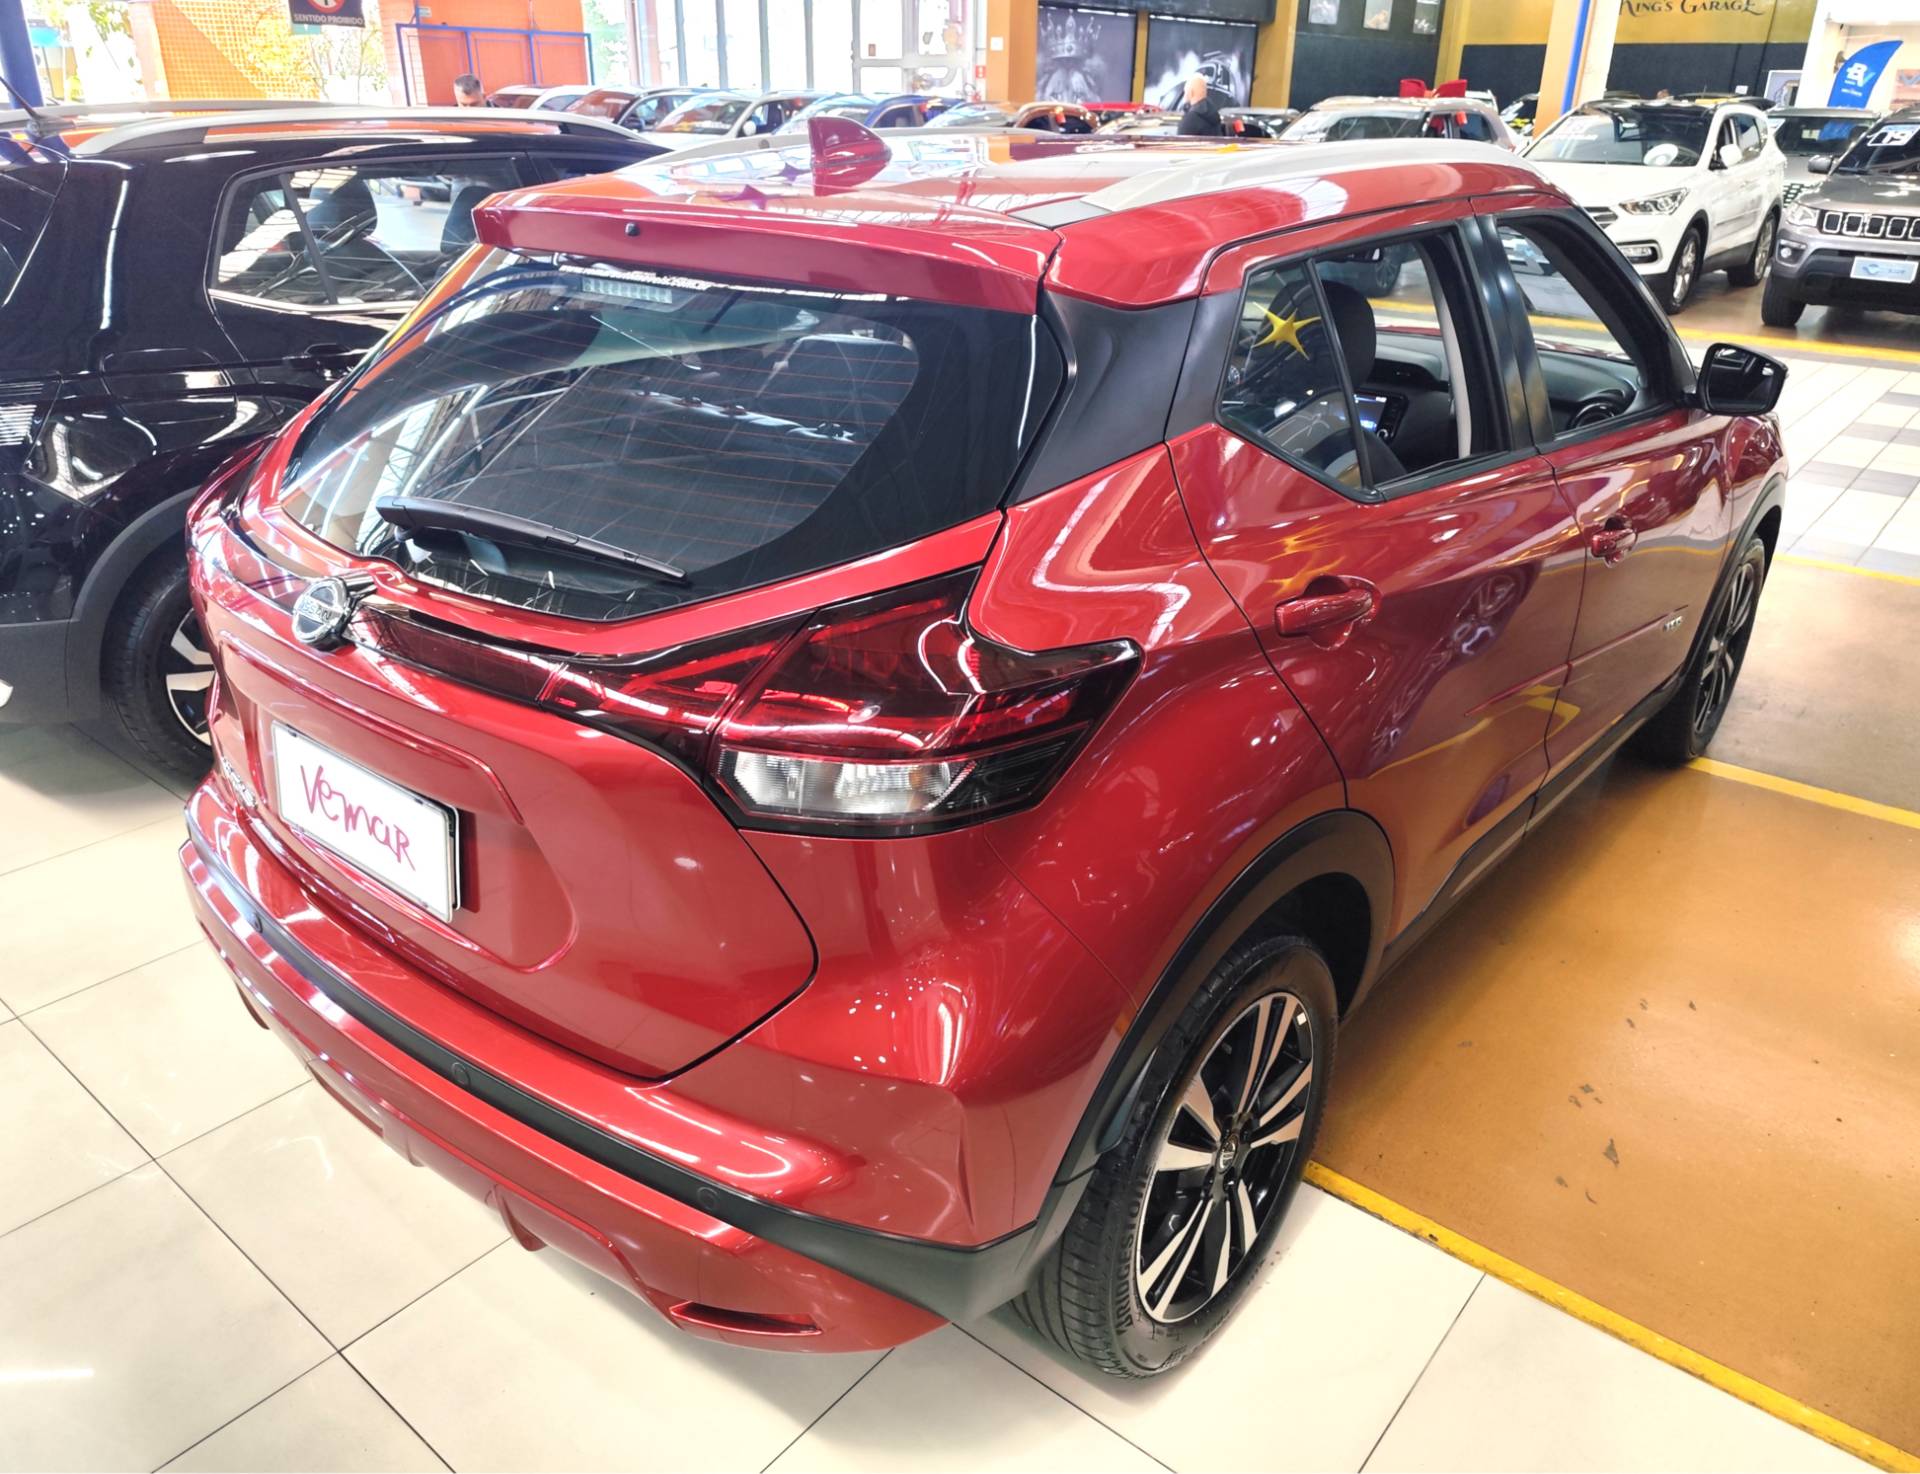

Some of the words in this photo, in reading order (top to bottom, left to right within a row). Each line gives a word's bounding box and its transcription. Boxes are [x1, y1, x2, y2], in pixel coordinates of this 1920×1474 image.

[1680, 0, 1764, 15] GARAGE
[294, 14, 325, 23] SENTIDO
[327, 15, 363, 24] PROIBIDO
